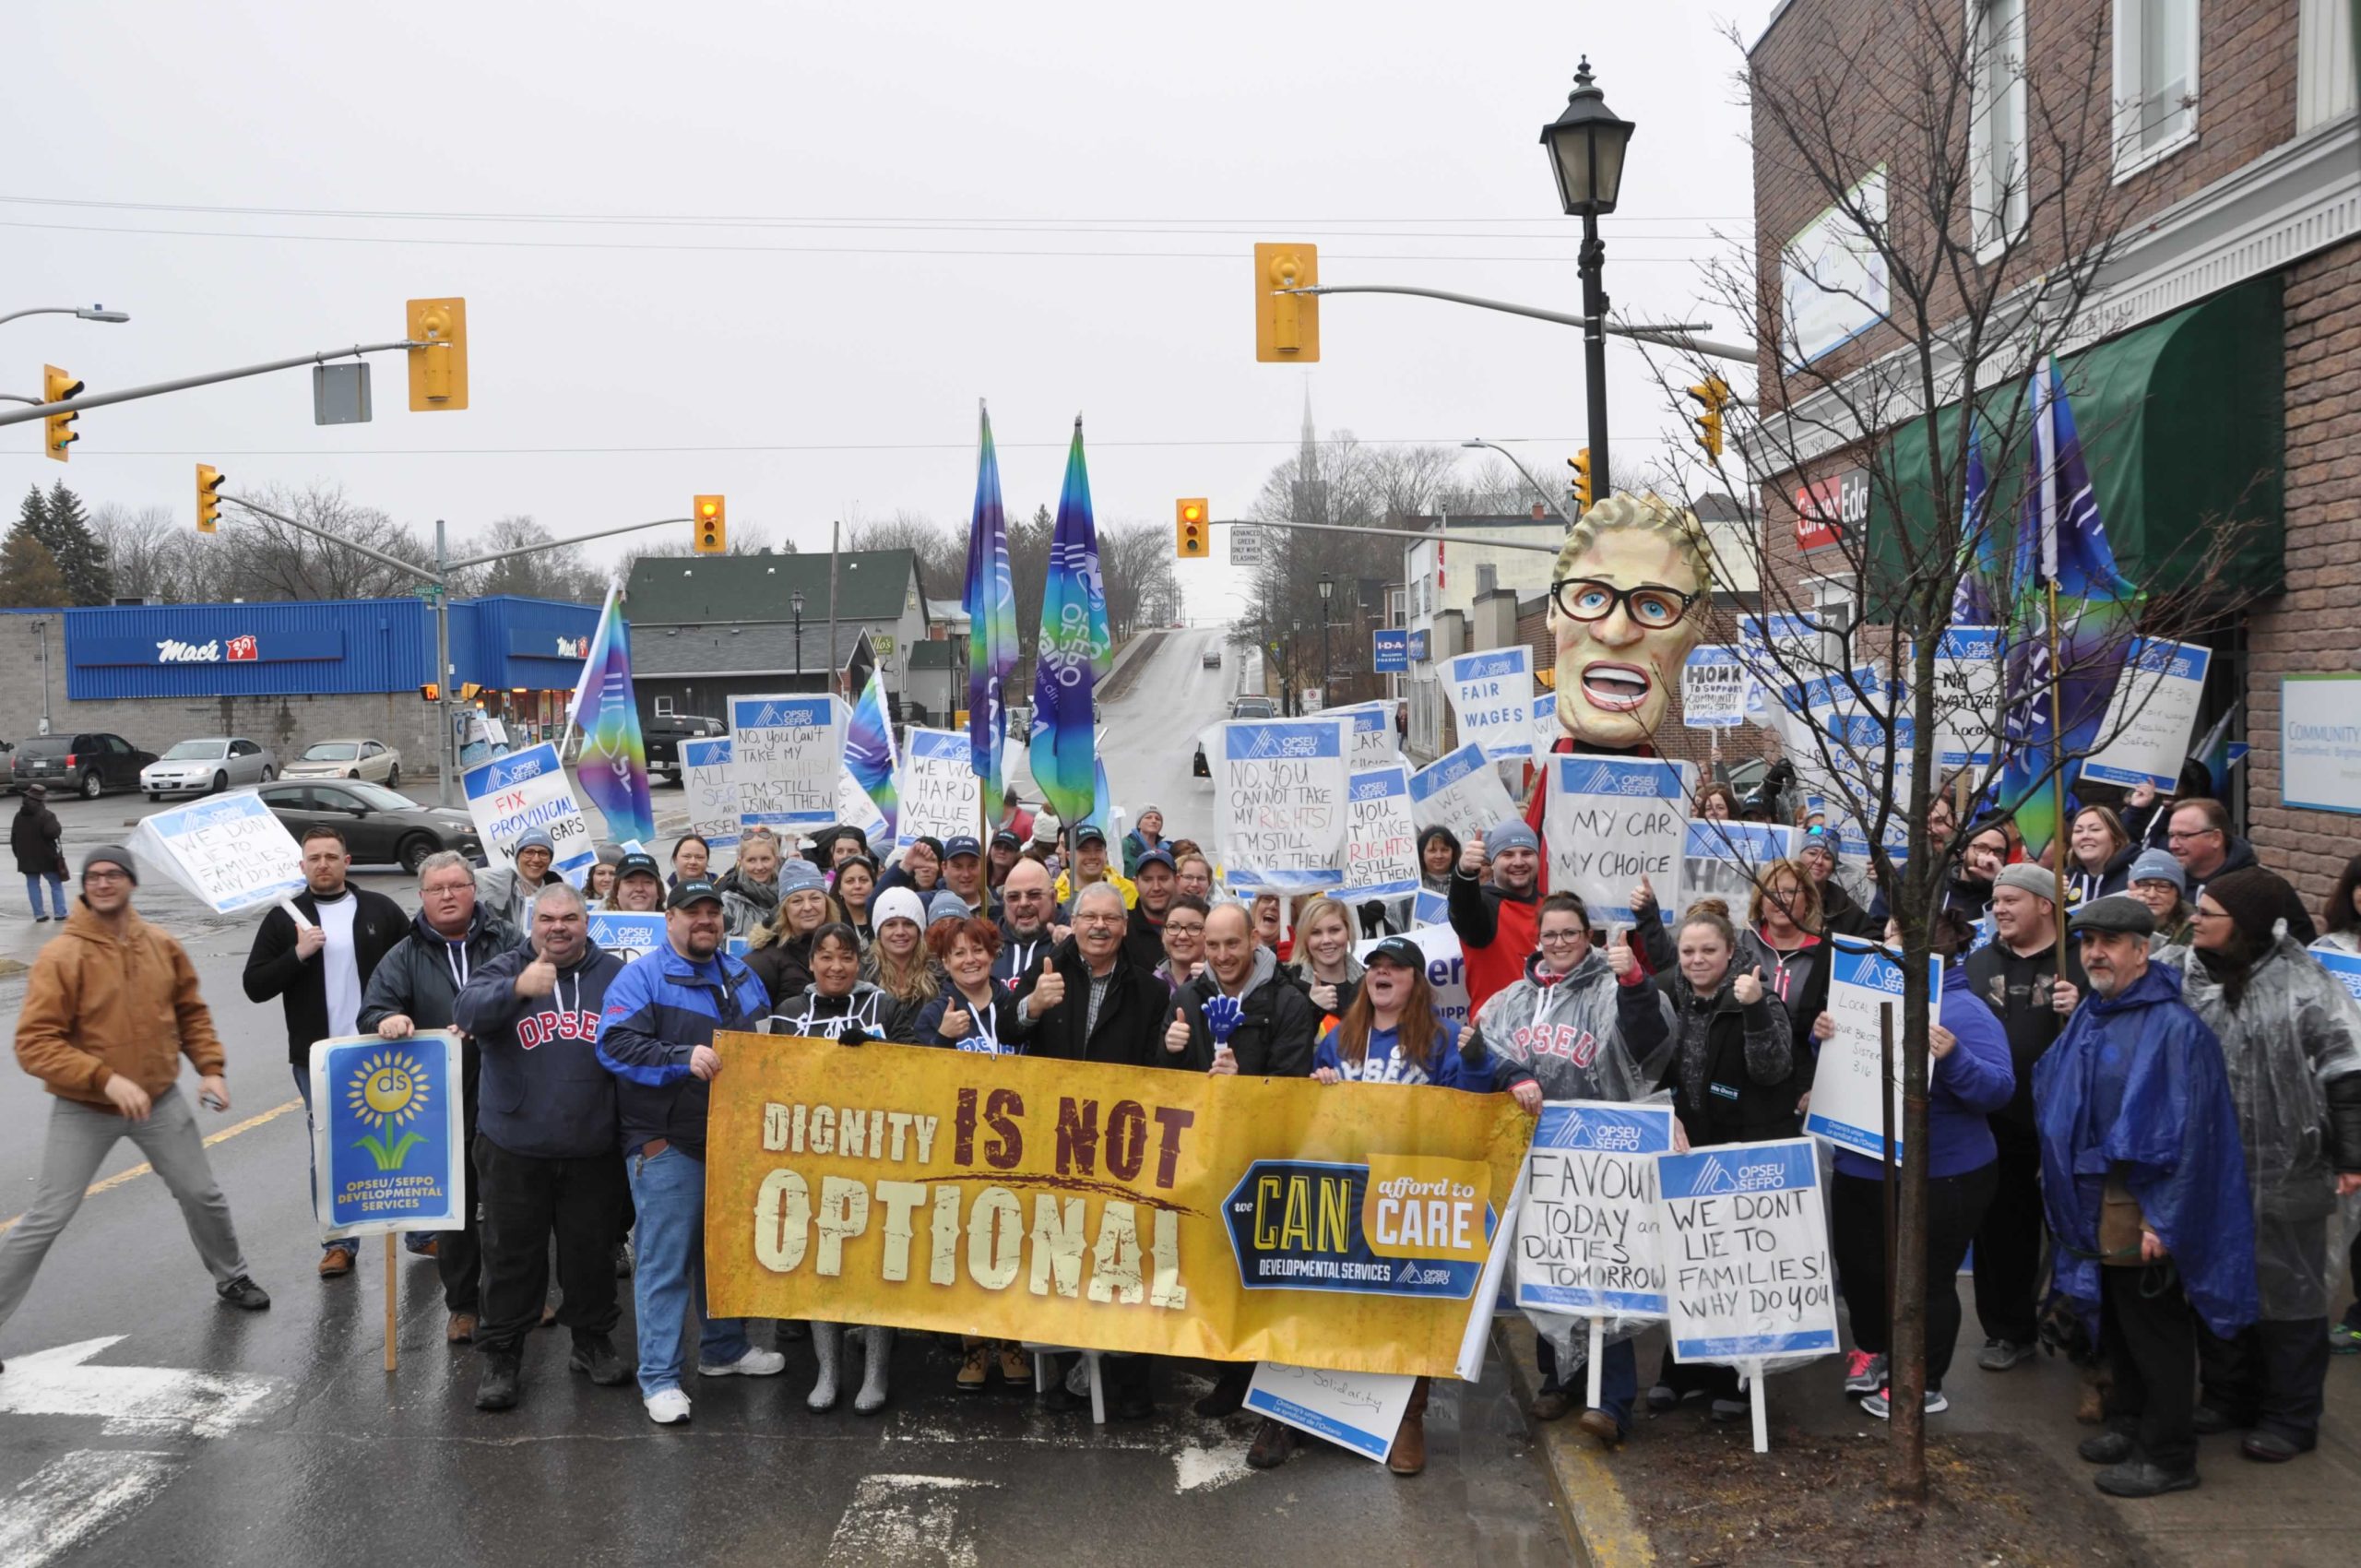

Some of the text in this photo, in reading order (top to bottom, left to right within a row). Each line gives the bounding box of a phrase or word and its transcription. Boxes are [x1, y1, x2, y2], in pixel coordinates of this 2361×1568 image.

[1841, 476, 1869, 531] Edg
[156, 638, 220, 663] Mac's
[1686, 665, 1741, 683] HONK
[1943, 672, 1968, 690] NO
[1462, 683, 1500, 701] FAIR
[1690, 684, 1701, 693] TO
[1687, 693, 1738, 704] COMMUNITY
[784, 709, 813, 718] OPSEU
[784, 718, 813, 726] SEFPO
[1465, 707, 1523, 728] WAGES
[1354, 725, 1372, 733] EFPO
[1282, 746, 1317, 756] SEFPO
[1283, 736, 1318, 748] OPSEU
[738, 746, 802, 764] TAKE MY
[511, 758, 540, 775] OPSEU
[514, 767, 541, 782] SEFPO
[913, 757, 937, 776] WE
[1445, 759, 1470, 777] OPSEU
[1448, 766, 1472, 782] SEFPO
[692, 767, 735, 788] ALL
[1359, 781, 1388, 792] OPSEU
[1621, 775, 1659, 786] OPSEU
[771, 779, 820, 796] STILL
[919, 781, 975, 802] HARD
[1299, 787, 1333, 805] TAKE
[1360, 790, 1387, 800] SEFPO
[1620, 785, 1657, 796] SEFPO
[495, 790, 527, 814] FIX
[741, 791, 833, 814] USING THEM
[1436, 787, 1465, 810] WE
[490, 796, 578, 841] PROVINCIAL
[906, 801, 969, 822] VALUE
[1235, 808, 1253, 825] MY
[1443, 805, 1474, 826] ARE
[551, 817, 585, 841] GAPS
[904, 822, 926, 839] US
[1365, 820, 1410, 838] TAKE
[1572, 810, 1617, 837] MY
[172, 828, 219, 852] WE
[1262, 833, 1312, 849] STILL
[1349, 837, 1414, 861] RIGHTS
[189, 841, 252, 867] LIE TO
[199, 847, 291, 880] FAMILIES
[1355, 857, 1406, 875] STILL
[209, 873, 244, 894] WHY
[617, 936, 651, 946] SEFPO
[618, 927, 653, 938] OPSEU
[1885, 967, 1904, 984] OPS
[1883, 980, 1904, 993] SEF
[516, 1009, 600, 1051] OPSE
[1513, 1023, 1598, 1068] PSEU
[377, 1067, 408, 1093] ds
[764, 1087, 1195, 1189] DIGNITY IS NOT
[1596, 1125, 1642, 1140] OPSEU
[1596, 1136, 1640, 1152] SEFPO
[1738, 1163, 1786, 1178] OPSEU
[347, 1176, 434, 1192] OPSEU/SEFPO
[1738, 1175, 1786, 1191] SEFPO
[338, 1187, 444, 1205] DEVELOPMENTAL
[362, 1198, 420, 1212] SERVICES
[1234, 1175, 1476, 1253] we CAN afford to
[1533, 1199, 1661, 1244] TODAY an
[1668, 1198, 1718, 1232] WE
[1376, 1199, 1474, 1250] CARE
[754, 1168, 1187, 1311] OPTIONAL
[1684, 1228, 1777, 1261] LIE TO
[1522, 1234, 1631, 1265] DUTIES
[1259, 1259, 1392, 1282] DEVELOPMENTAL SERVICES
[1423, 1269, 1451, 1278] OPSEU
[1679, 1251, 1826, 1291] FAMILIES!
[1423, 1277, 1450, 1286] SEFPO
[1679, 1290, 1738, 1320] WHY
[1313, 1370, 1383, 1414] Solidarity
